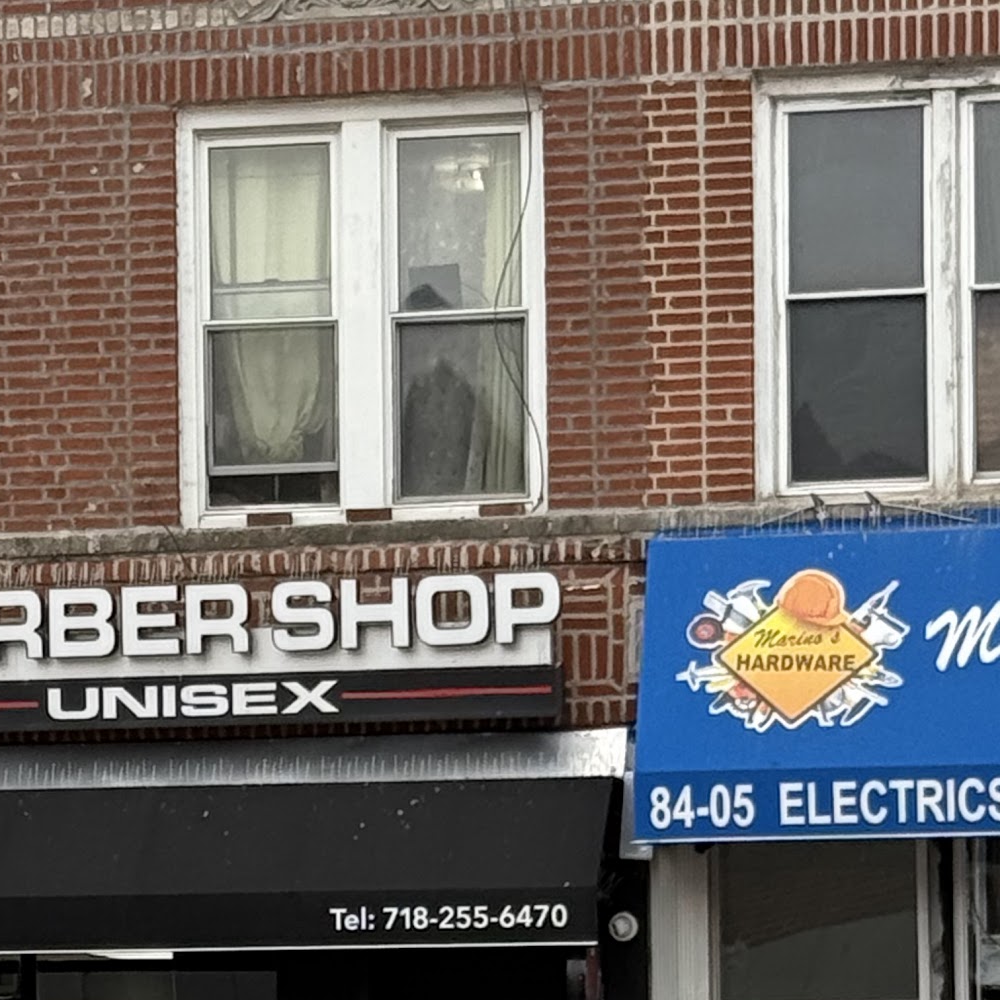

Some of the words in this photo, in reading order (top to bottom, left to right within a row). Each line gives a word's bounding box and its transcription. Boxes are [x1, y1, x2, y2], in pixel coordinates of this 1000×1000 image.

[271, 571, 561, 654] SHOP
[736, 653, 856, 672] HARDWARE
[47, 679, 340, 720] UNISEX
[650, 784, 755, 830] 84-05
[329, 906, 375, 931] Tel:
[382, 904, 568, 930] 718-255-6470
